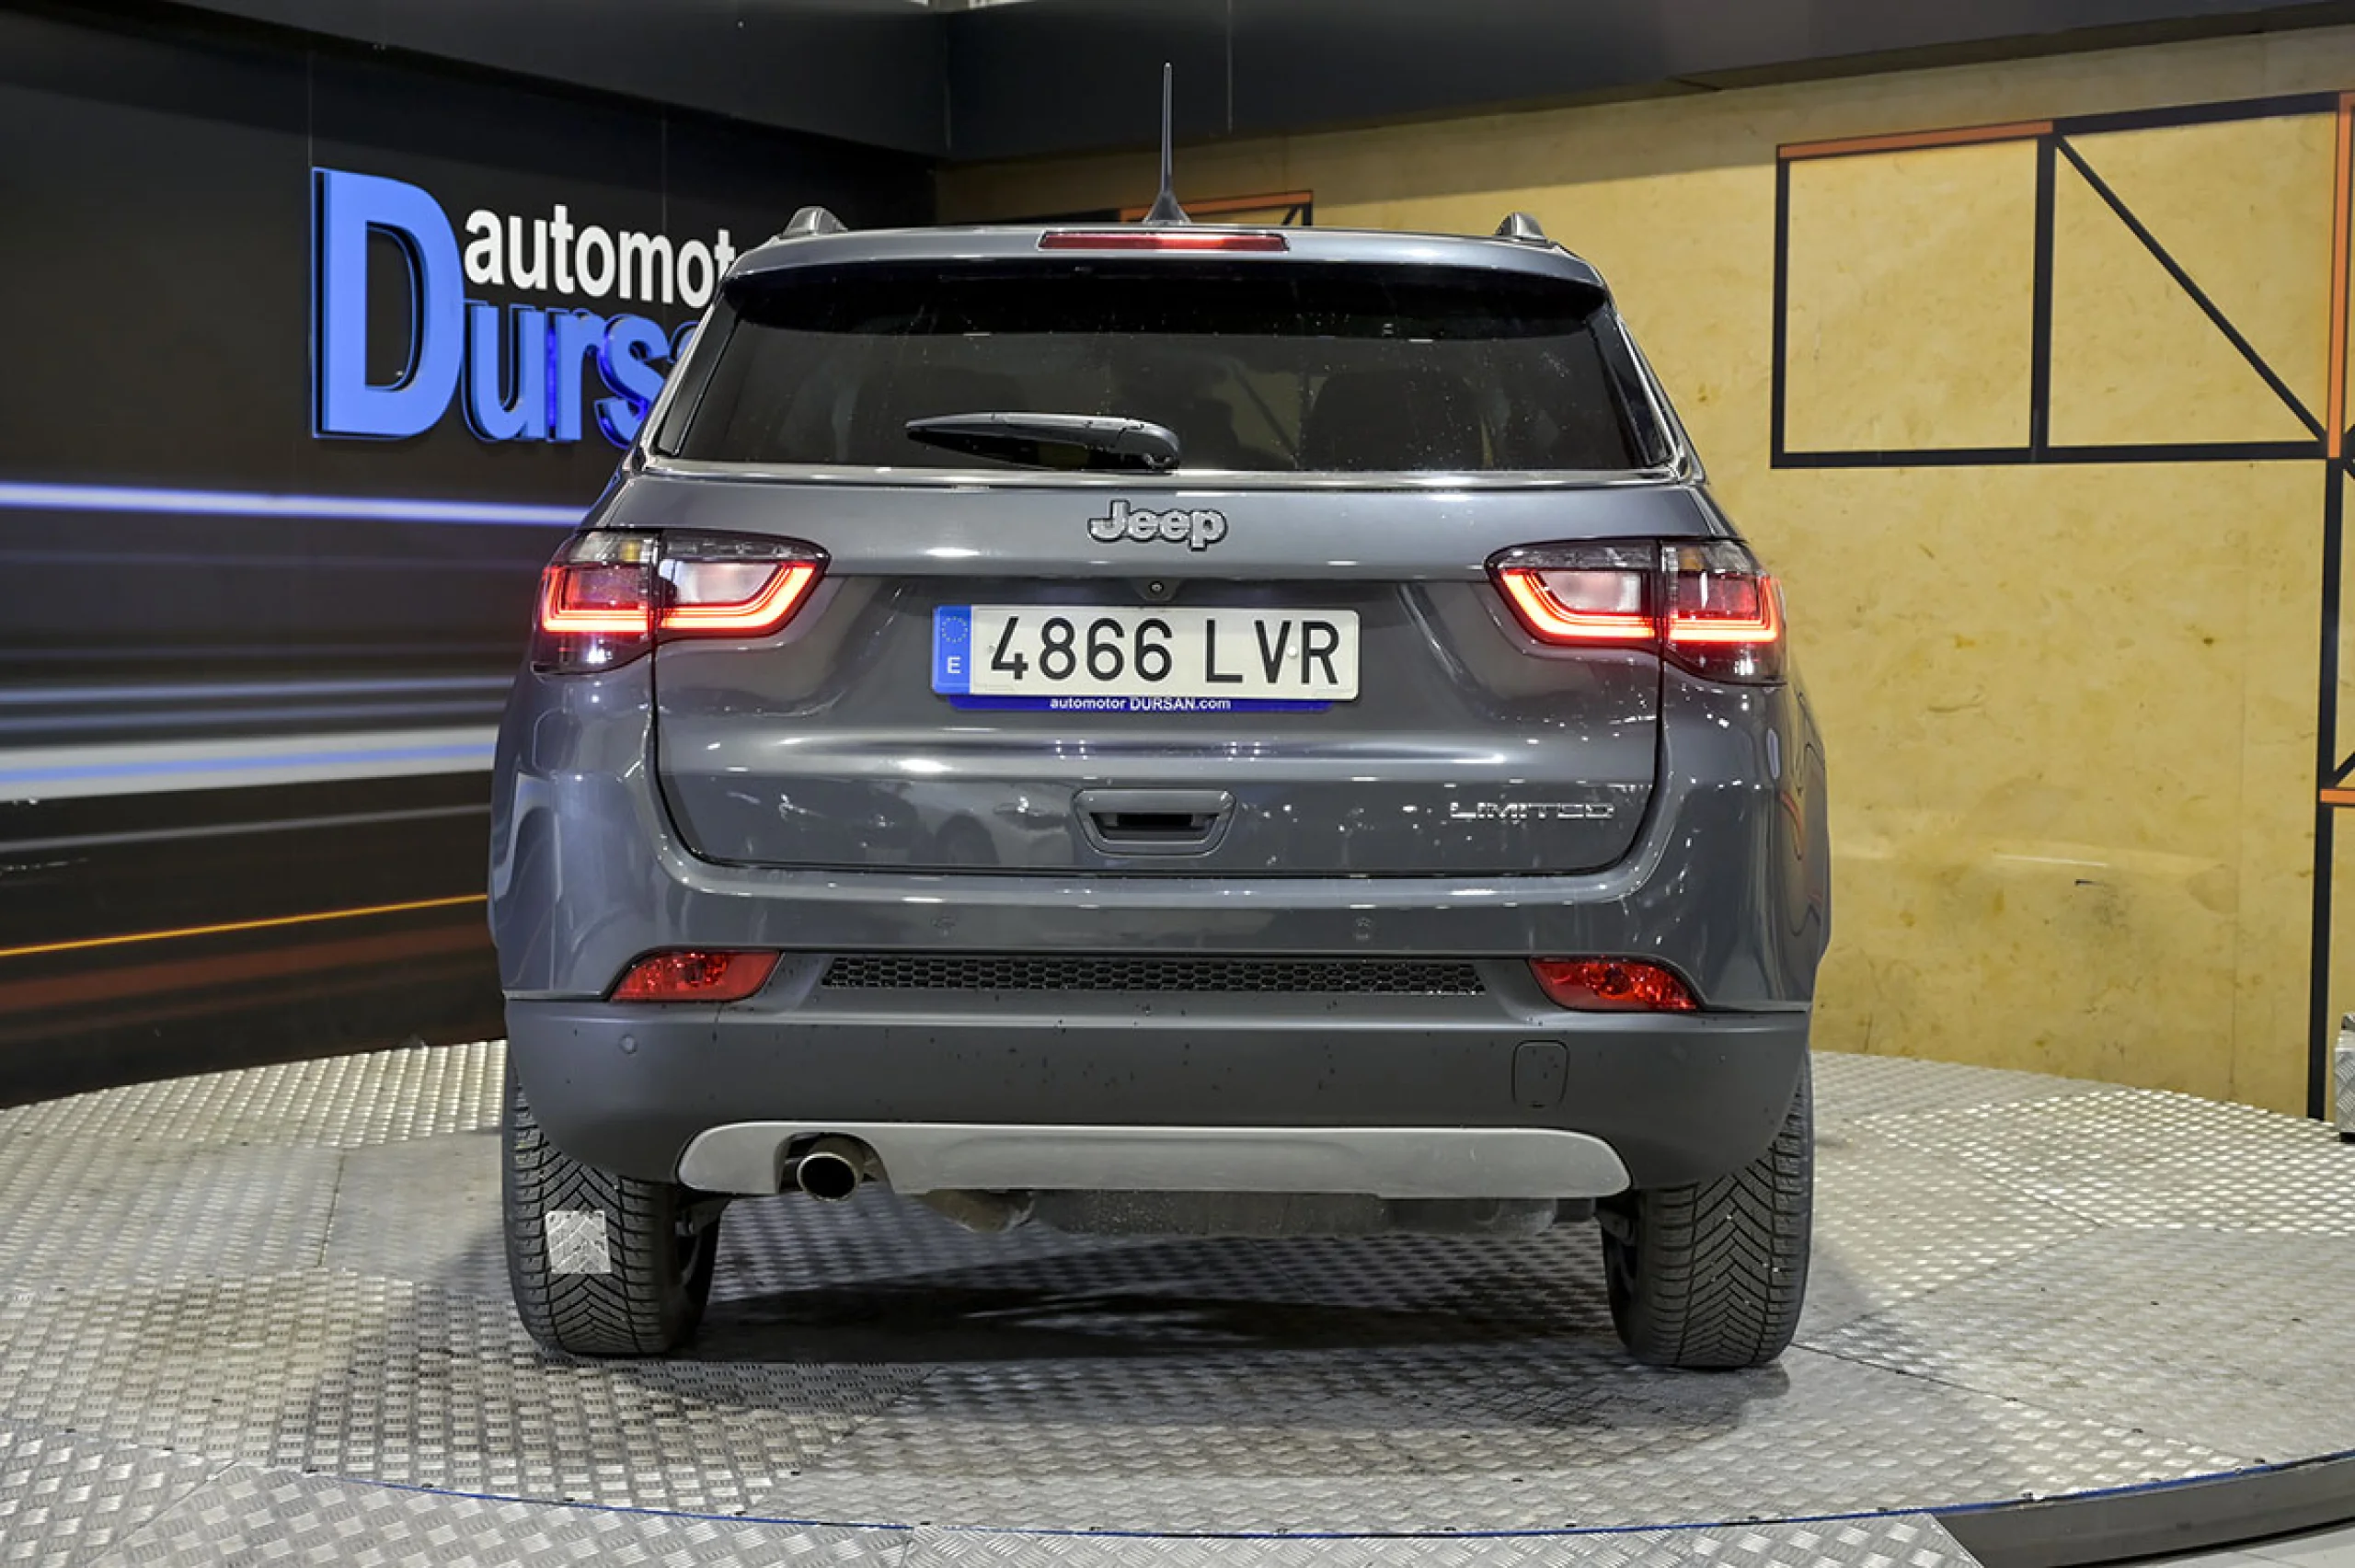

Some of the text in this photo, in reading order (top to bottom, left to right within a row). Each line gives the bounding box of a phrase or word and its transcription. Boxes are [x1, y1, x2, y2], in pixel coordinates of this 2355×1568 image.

[311, 166, 699, 449] Durs
[1087, 498, 1228, 551] Jeep
[946, 656, 961, 674] E
[990, 615, 1339, 684] 4866 LVR
[1050, 696, 1232, 712] automotor DURSAN.com
[1449, 802, 1614, 819] LIMITED
